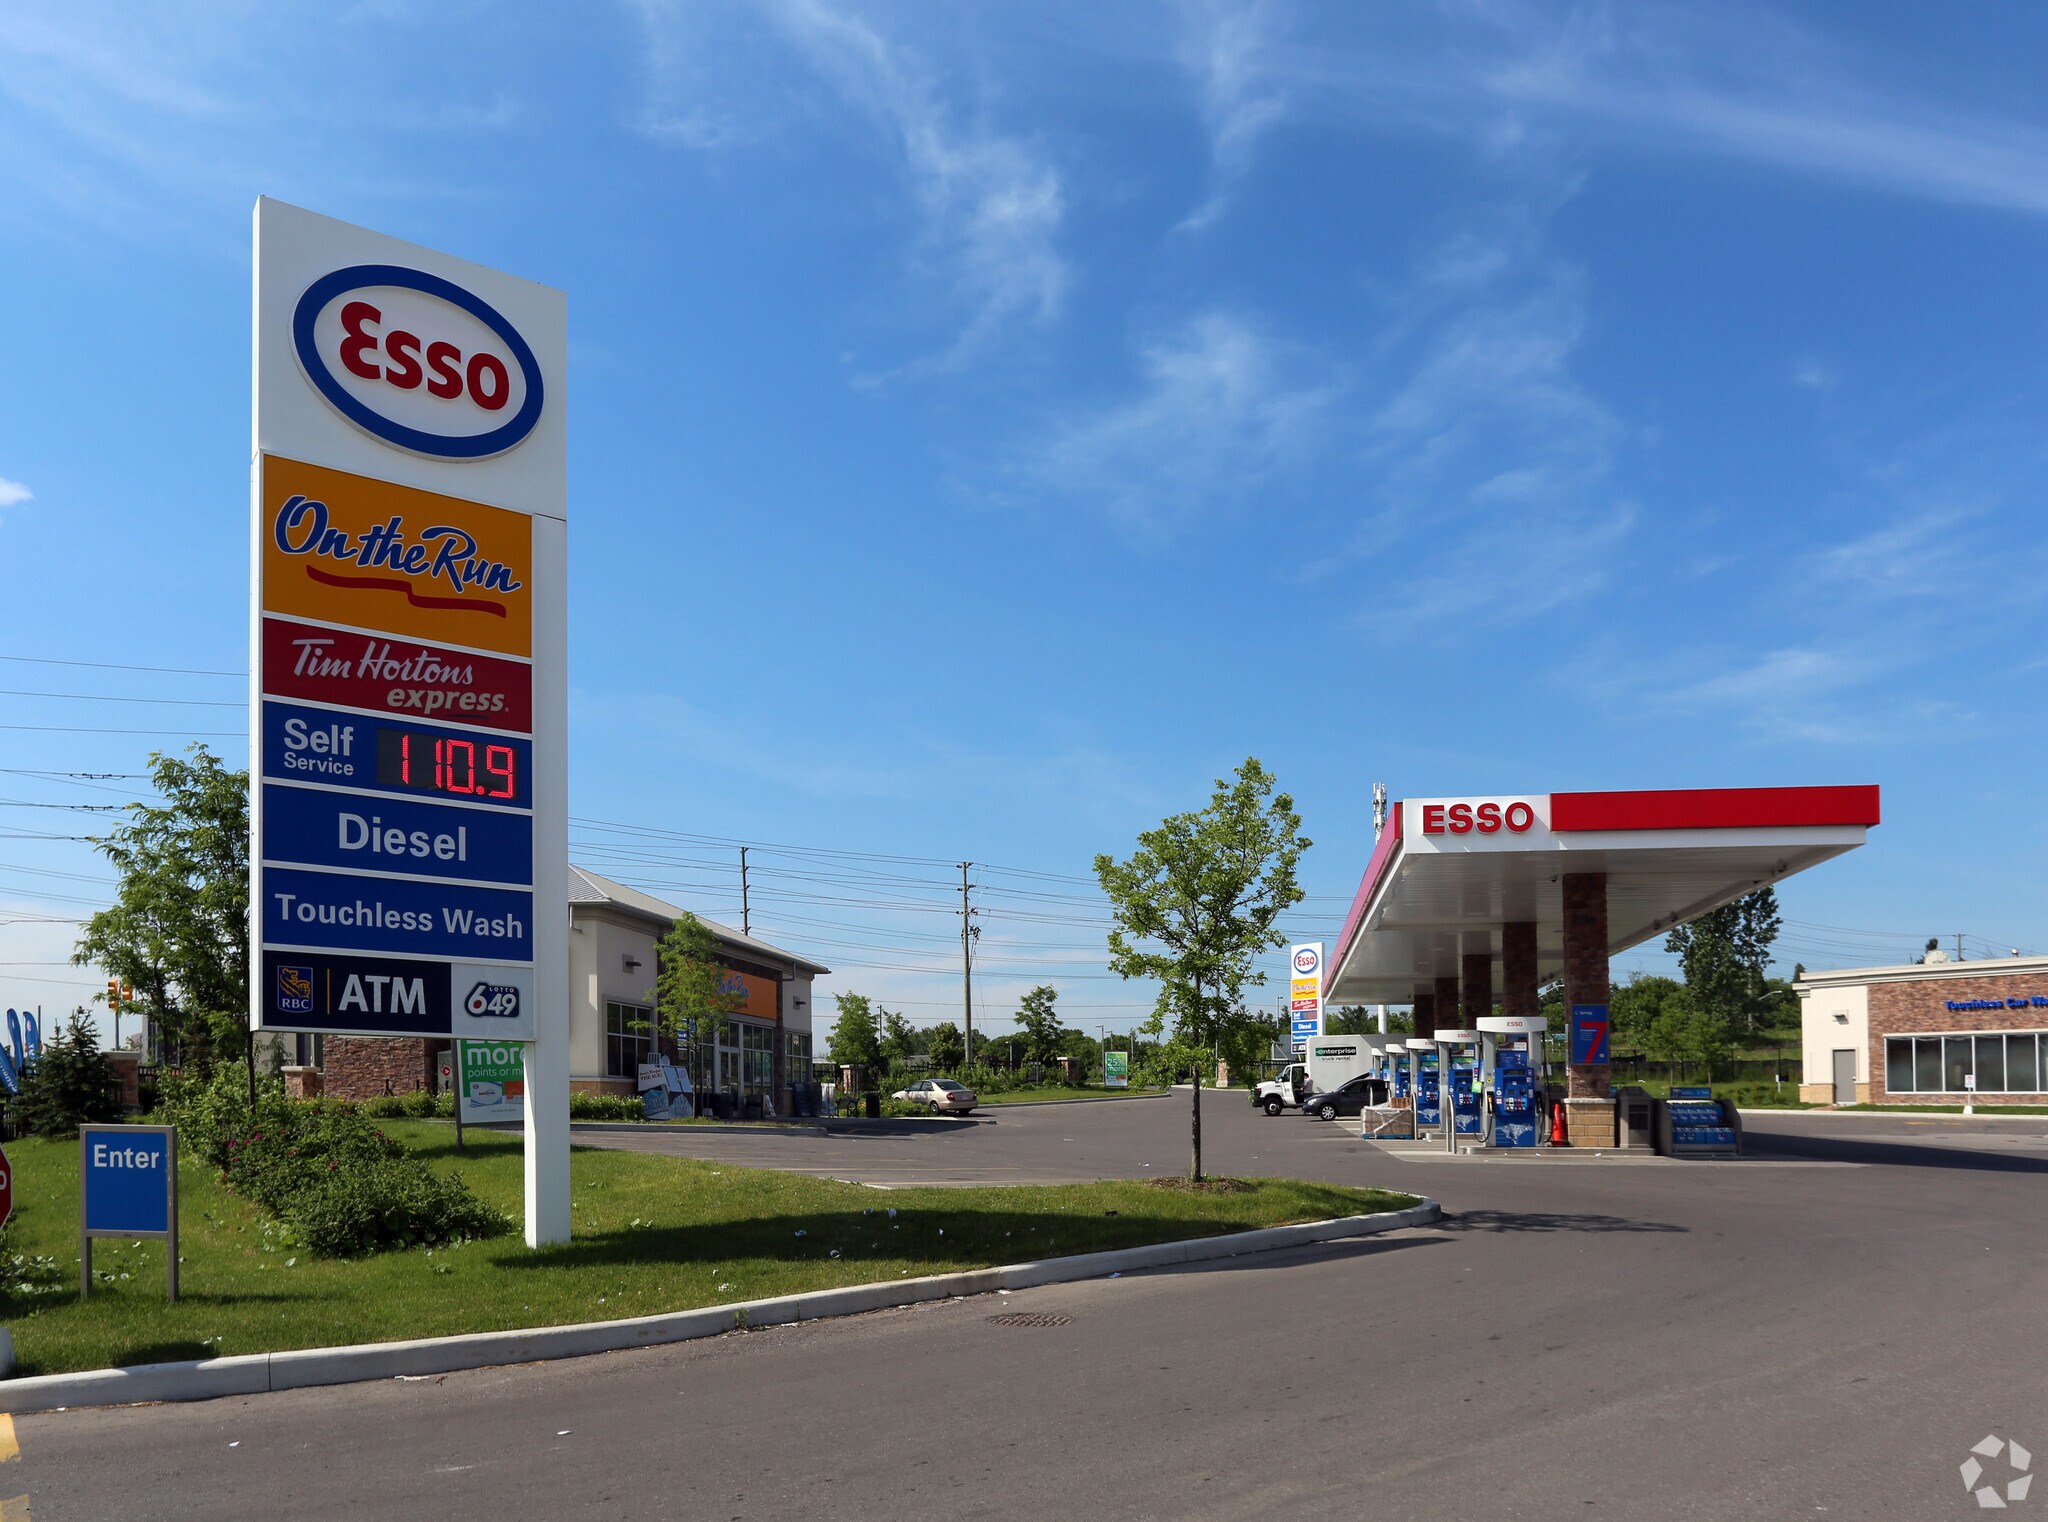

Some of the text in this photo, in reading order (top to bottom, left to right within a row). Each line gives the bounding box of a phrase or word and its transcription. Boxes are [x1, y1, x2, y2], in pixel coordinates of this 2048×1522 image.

[274, 494, 522, 594] On the Run
[291, 638, 474, 686] Tim Hortons
[283, 717, 354, 757] Self
[283, 751, 354, 776] Service
[401, 733, 515, 799] 110.9
[1423, 801, 1534, 834] ESSO
[338, 812, 468, 862] Diesel
[274, 893, 523, 940] Touchless Wash
[281, 997, 310, 1011] RBC
[338, 972, 427, 1015] ATM
[1945, 999, 2003, 1010] Touchless
[2006, 996, 2027, 1007] Car
[1298, 1022, 1312, 1030] Diesel
[467, 1067, 497, 1080] points
[499, 1068, 509, 1077] or
[1107, 1058, 1125, 1067] 25%
[93, 1143, 160, 1169] Enter
